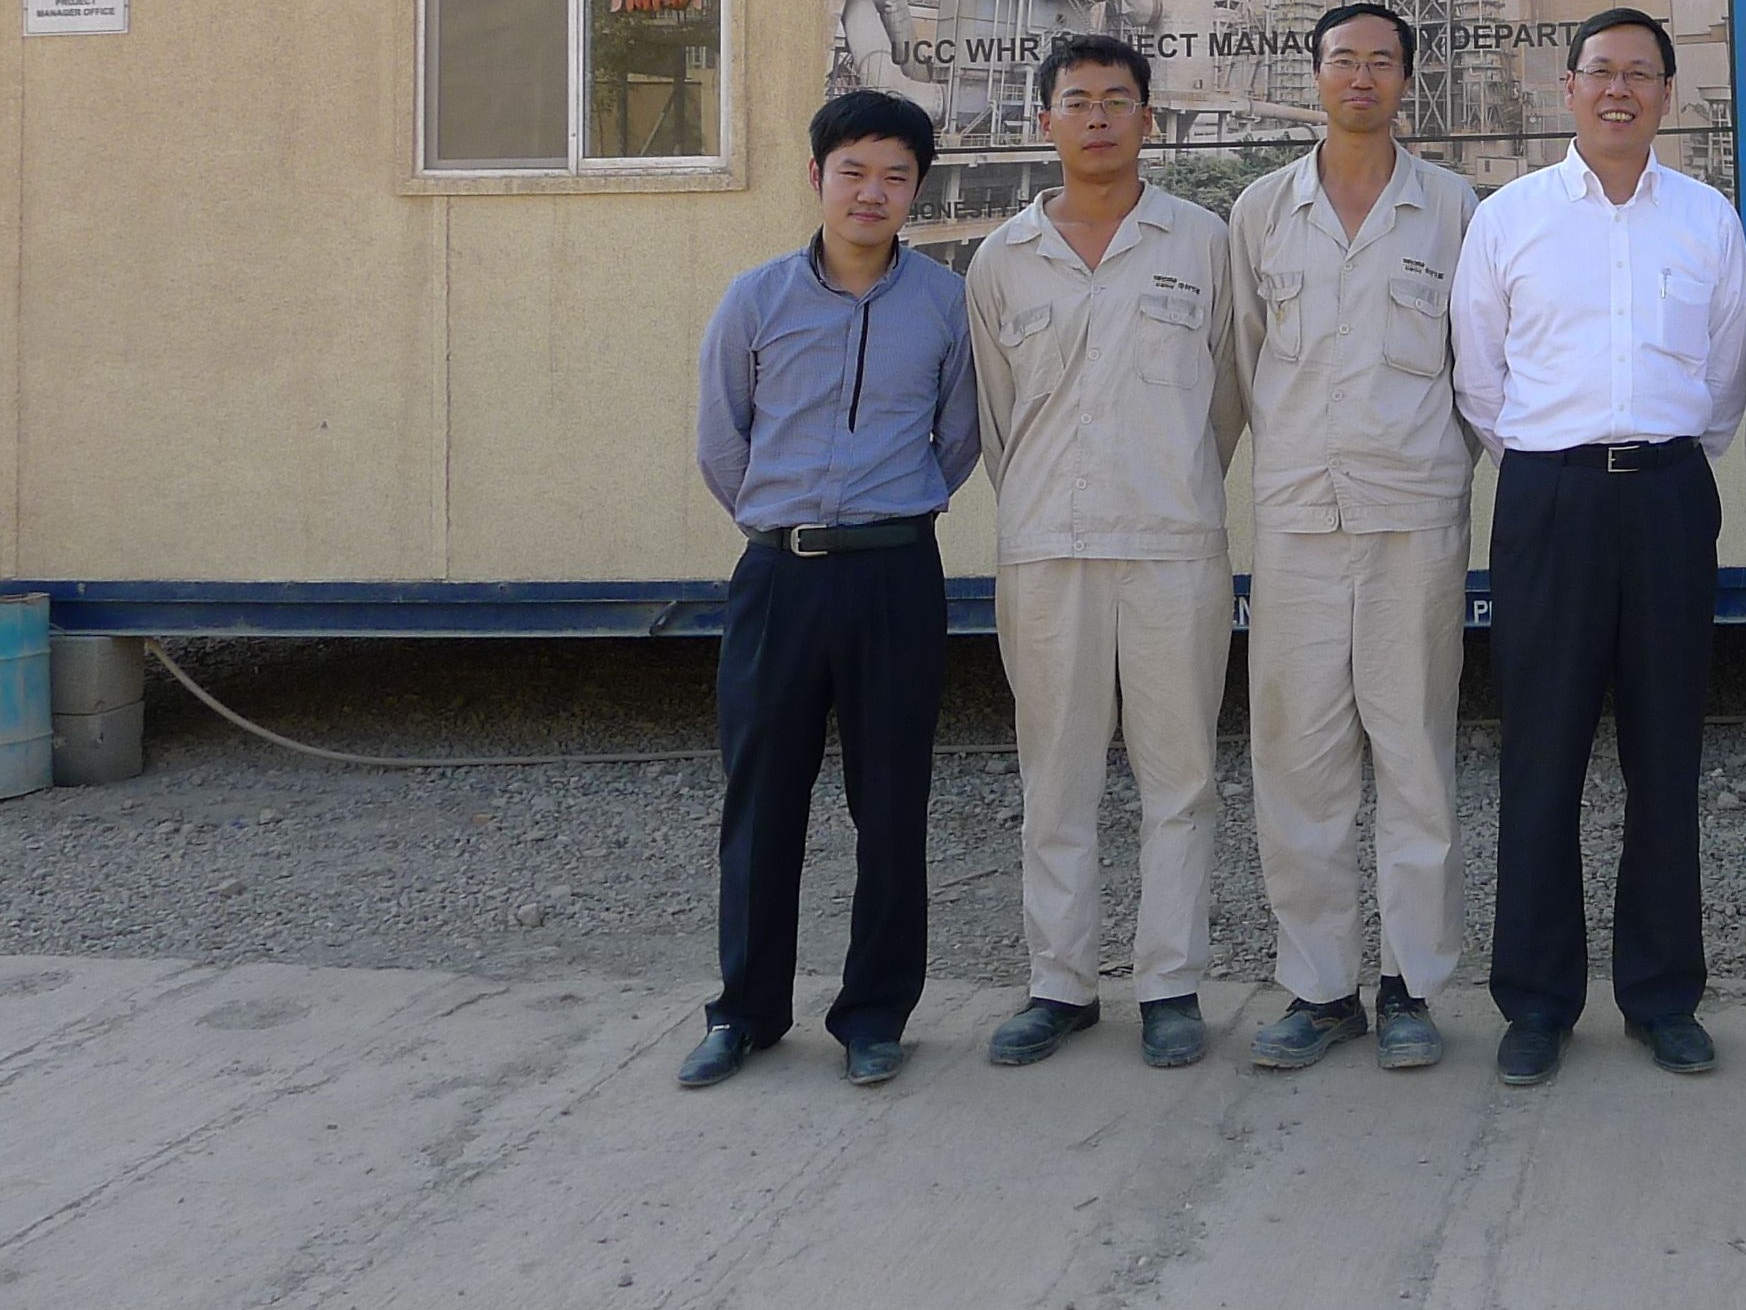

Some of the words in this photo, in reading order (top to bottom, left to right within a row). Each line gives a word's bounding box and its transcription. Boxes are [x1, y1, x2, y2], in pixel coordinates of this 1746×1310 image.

[36, 8, 82, 18] MANAGER
[83, 7, 116, 17] OFFICE
[890, 39, 957, 67] UCC
[966, 36, 1040, 63] WHR
[1051, 32, 1199, 60] PECT
